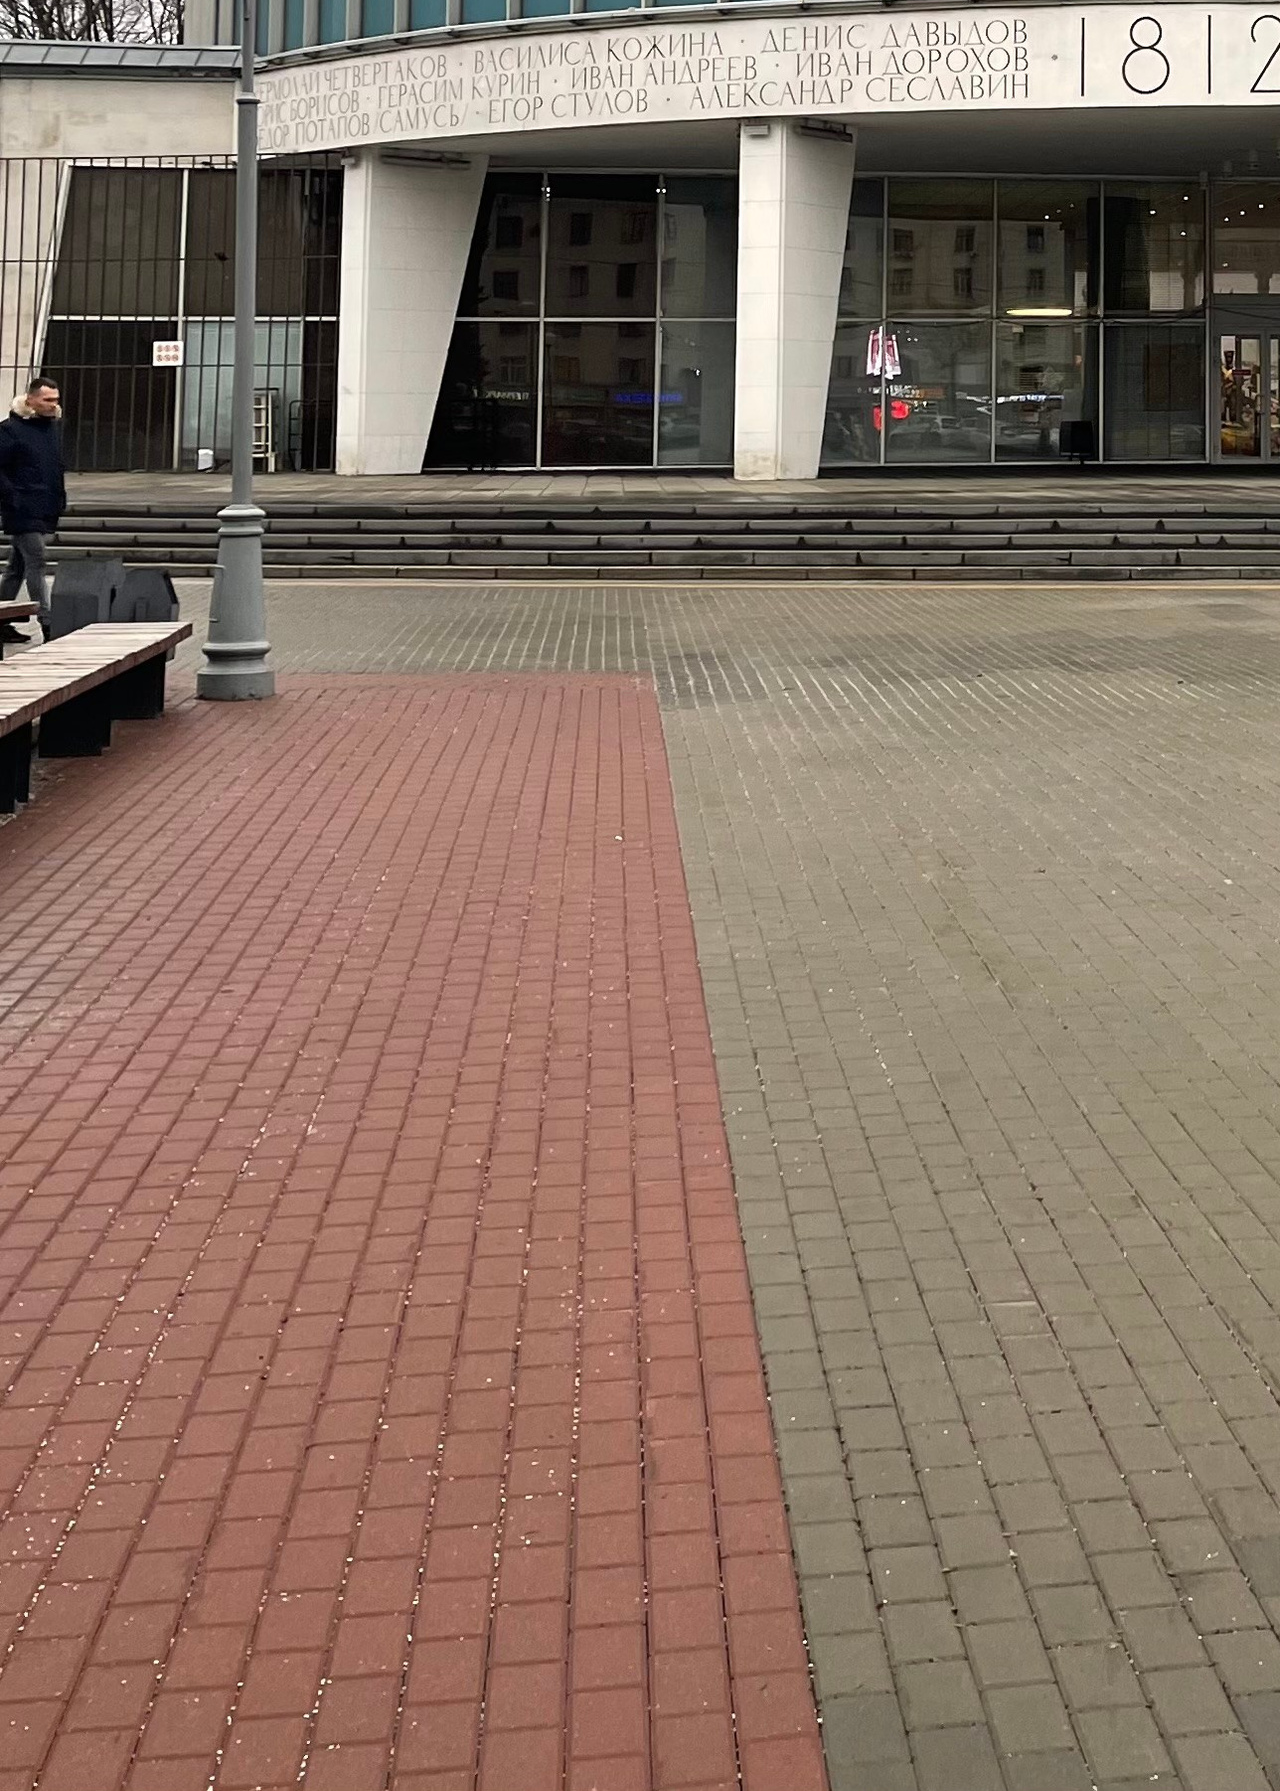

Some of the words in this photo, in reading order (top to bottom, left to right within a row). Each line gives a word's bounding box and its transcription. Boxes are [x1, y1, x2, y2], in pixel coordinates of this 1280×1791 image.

[290, 90, 360, 121] БОРИСОВ
[378, 78, 463, 109] ГЕРАСИМ
[472, 70, 540, 100] КУРИН
[571, 63, 633, 90] ИВАН
[643, 56, 757, 86] АНДРЕЕВ
[796, 51, 872, 78] ИВАН
[882, 46, 1029, 76] ДОРОХОВ
[325, 54, 447, 91] ЧЕТВЕРТАКОВ
[474, 41, 597, 74] ВАСИЛИСА
[607, 31, 724, 63] КОЖИНА
[760, 24, 867, 54] ДЕНИС
[881, 19, 1029, 49] ДАВЫДОВ
[258, 124, 290, 151] ЕДОР
[295, 113, 370, 145] ПОТАПОВ
[488, 96, 544, 124] ЕГОР
[551, 88, 648, 118] СТУЛОВ
[689, 78, 854, 110] АЛЕКСАНДР
[865, 73, 1030, 103] СЕСЛАВИН
